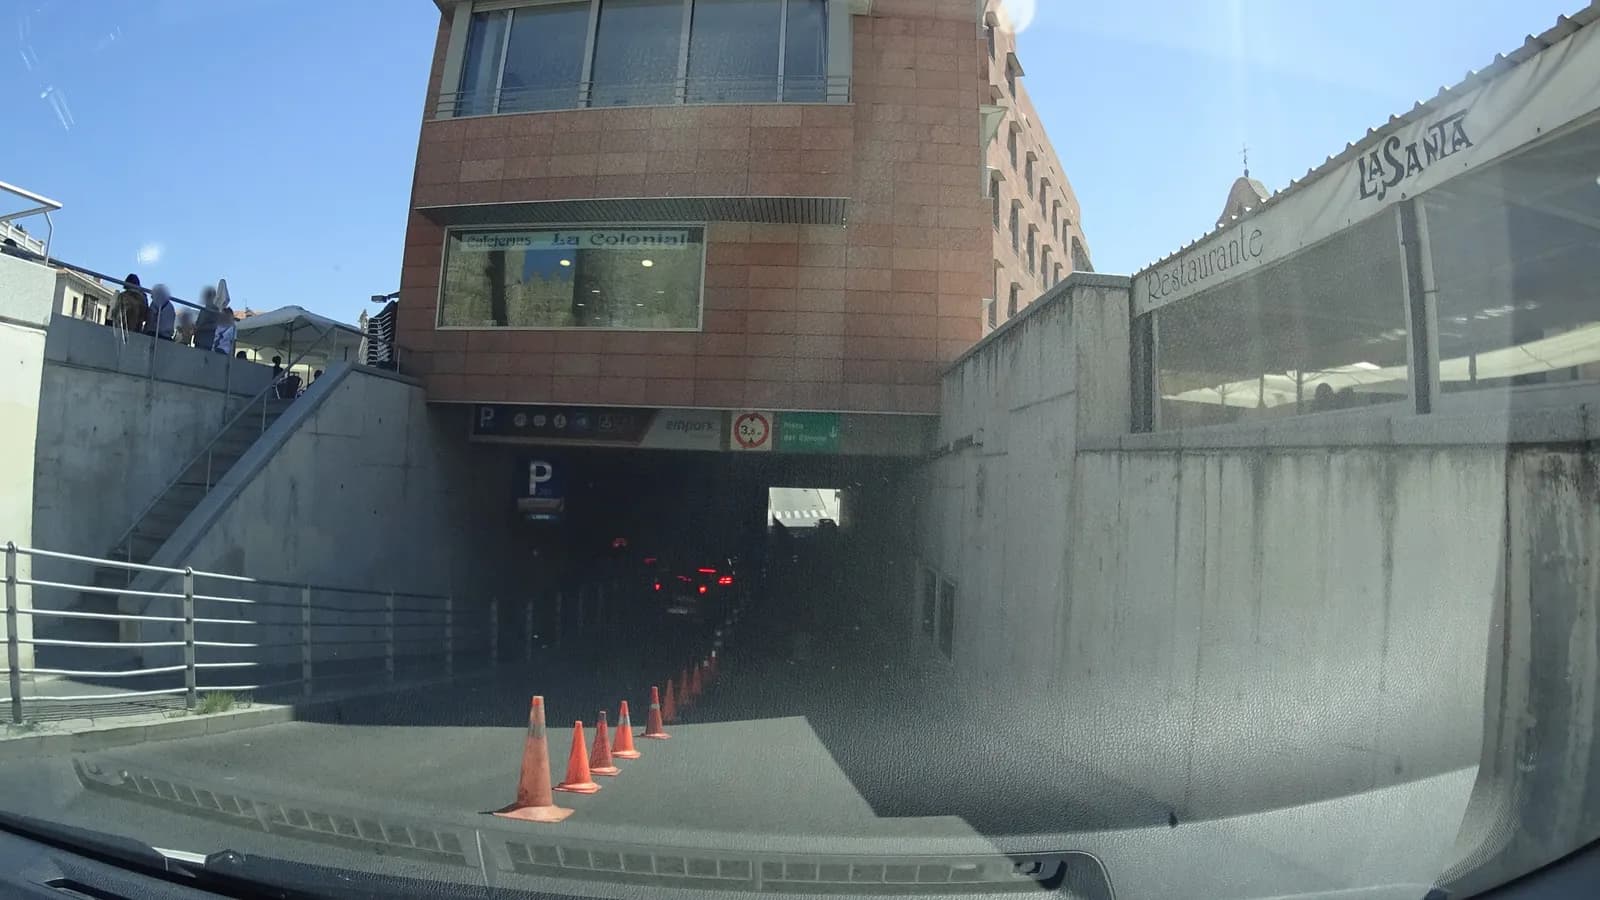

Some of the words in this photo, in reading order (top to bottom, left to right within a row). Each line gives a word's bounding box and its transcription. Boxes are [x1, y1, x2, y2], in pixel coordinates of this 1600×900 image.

[552, 232, 579, 246] La
[590, 232, 685, 246] Colonial
[1145, 225, 1264, 303] Restaurante
[529, 460, 552, 496] P
